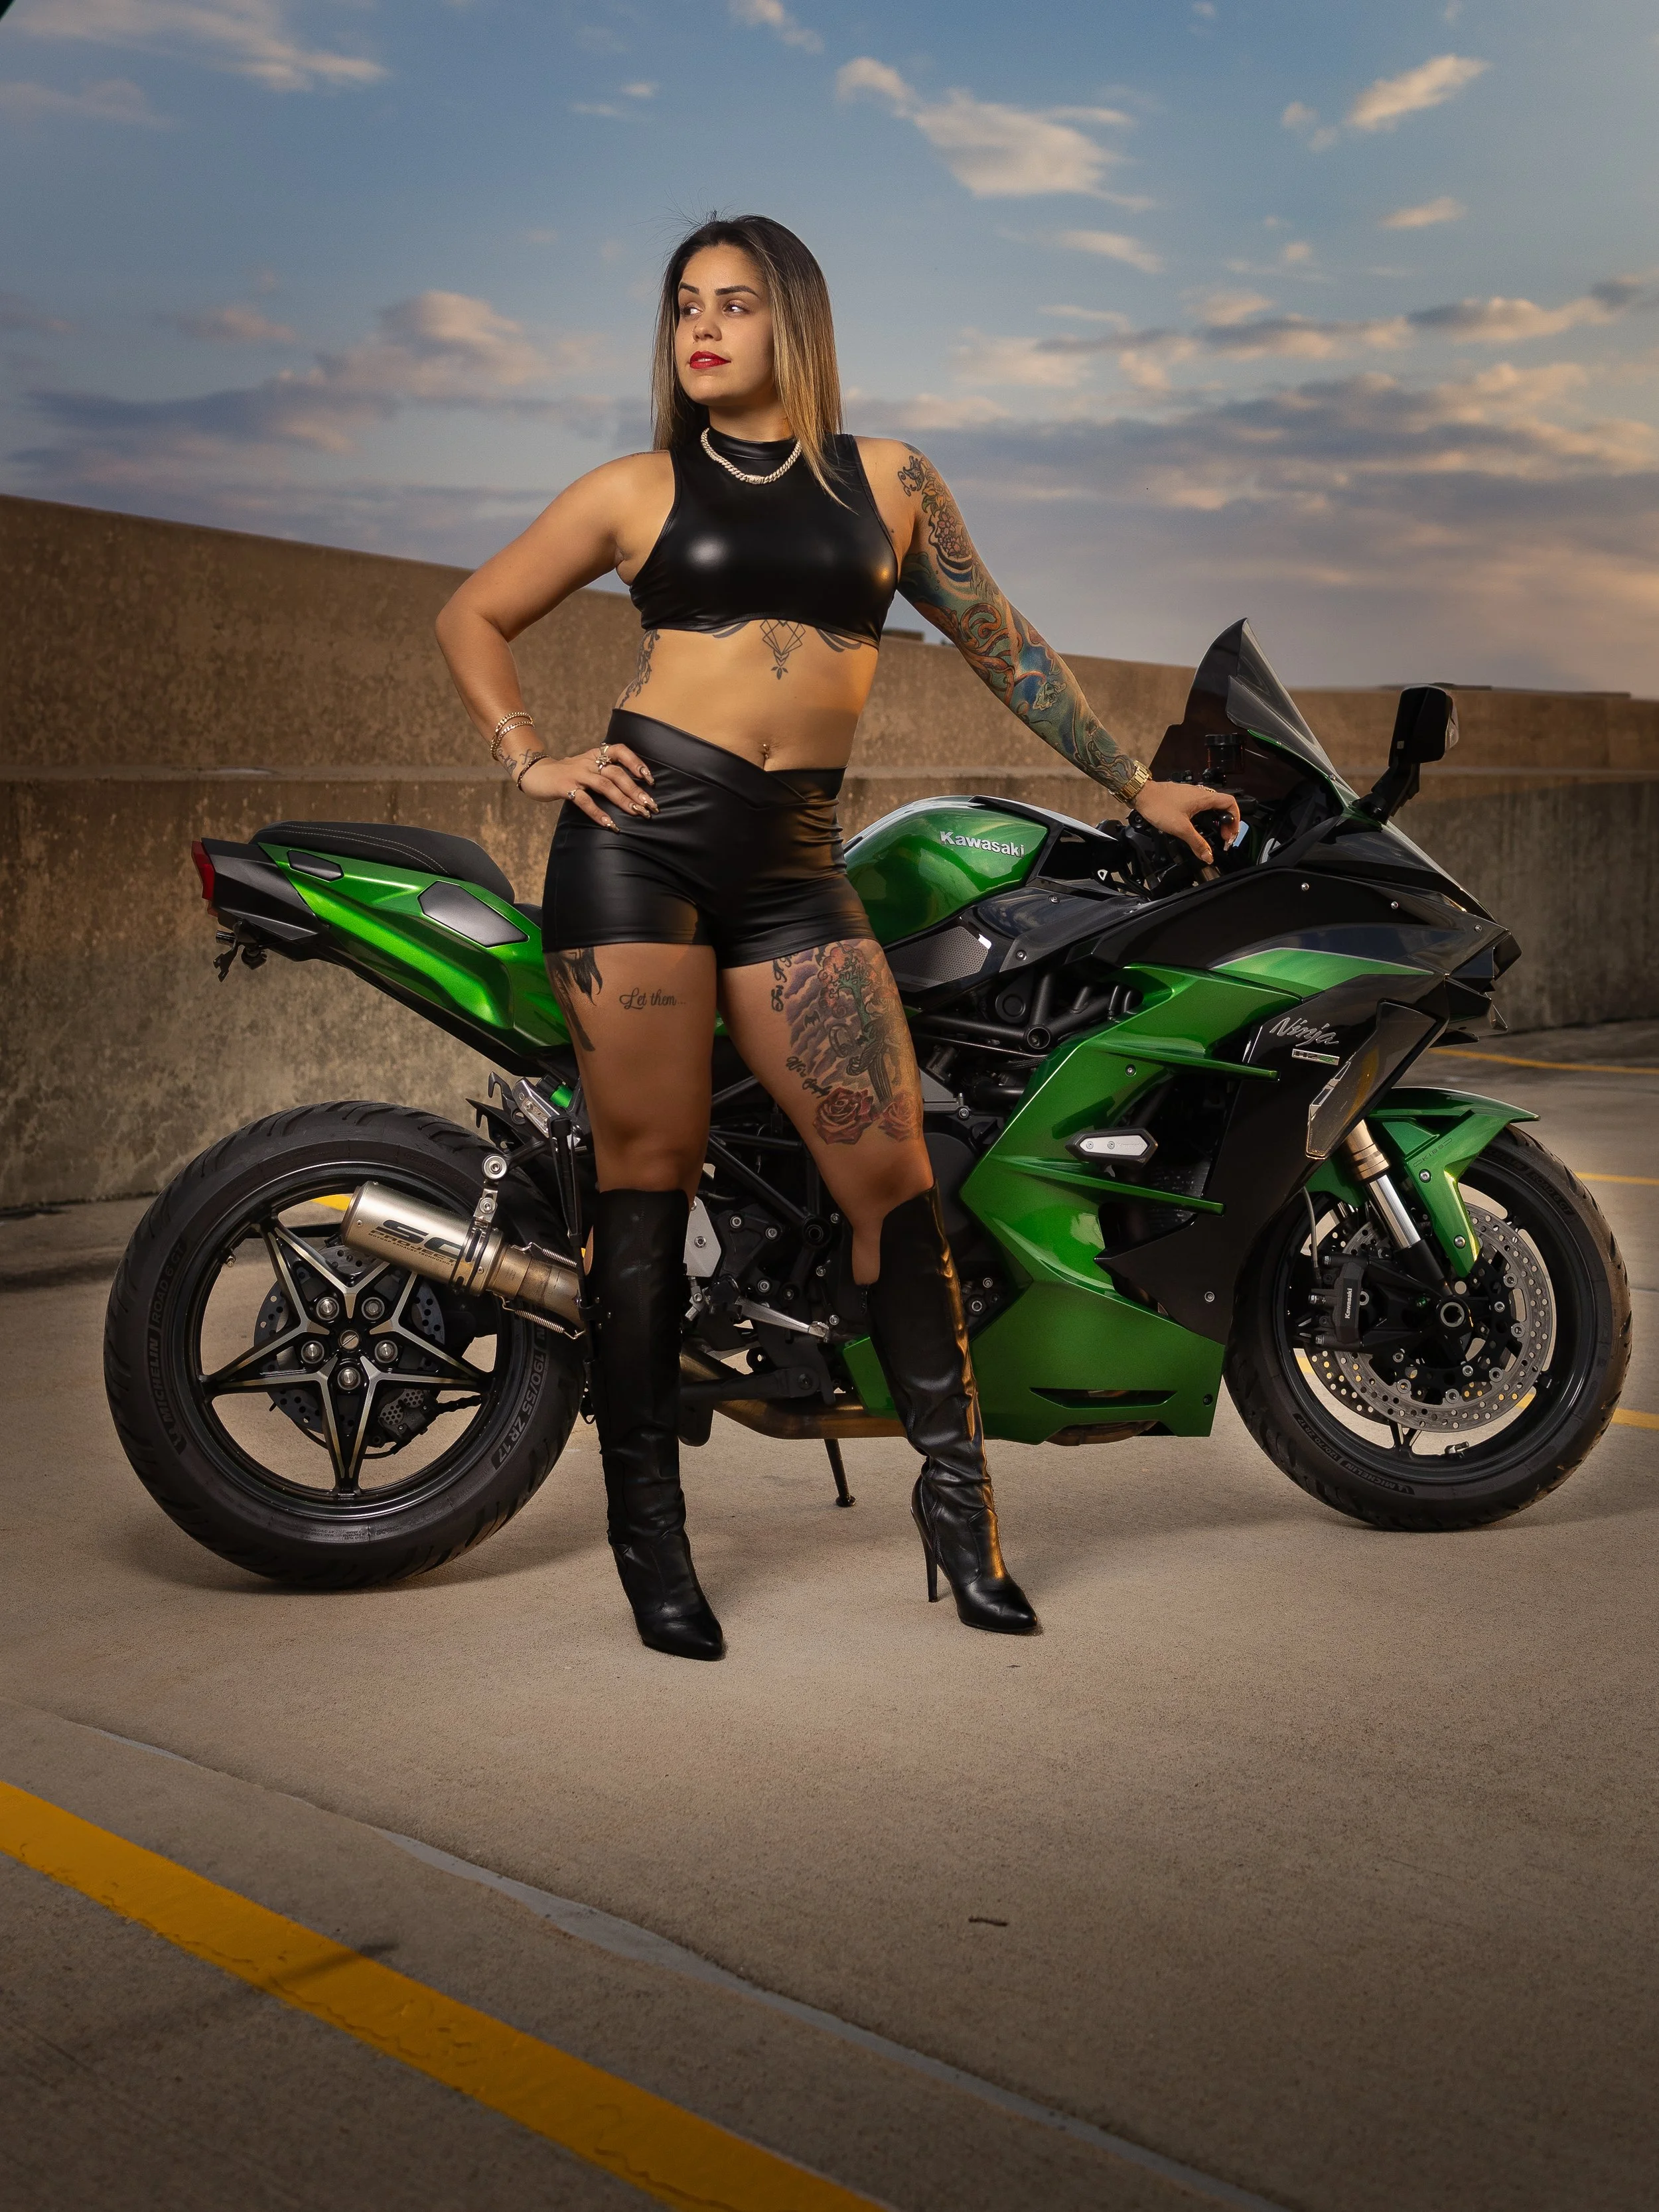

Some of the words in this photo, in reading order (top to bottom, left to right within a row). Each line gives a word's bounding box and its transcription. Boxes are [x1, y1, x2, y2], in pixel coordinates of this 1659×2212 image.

[940, 831, 1025, 858] Kawasaki
[619, 987, 647, 1009] Let
[1269, 1017, 1339, 1047] Ninja
[1529, 1172, 1555, 1194] ROAD
[171, 1243, 187, 1265] GT
[393, 1242, 417, 1253] EXHAUST
[418, 1251, 455, 1266] TECHNOLOGY
[165, 1265, 174, 1276] 6
[152, 1280, 168, 1324] ROAD
[147, 1336, 174, 1422] MICHELIN
[522, 1354, 544, 1416] 190/55
[508, 1416, 526, 1442] ZR
[1297, 1418, 1307, 1426] 17
[1305, 1427, 1314, 1437] ZR
[498, 1442, 511, 1463] 17
[1314, 1437, 1338, 1460] 120/70
[1345, 1463, 1396, 1489] MICHELIN
